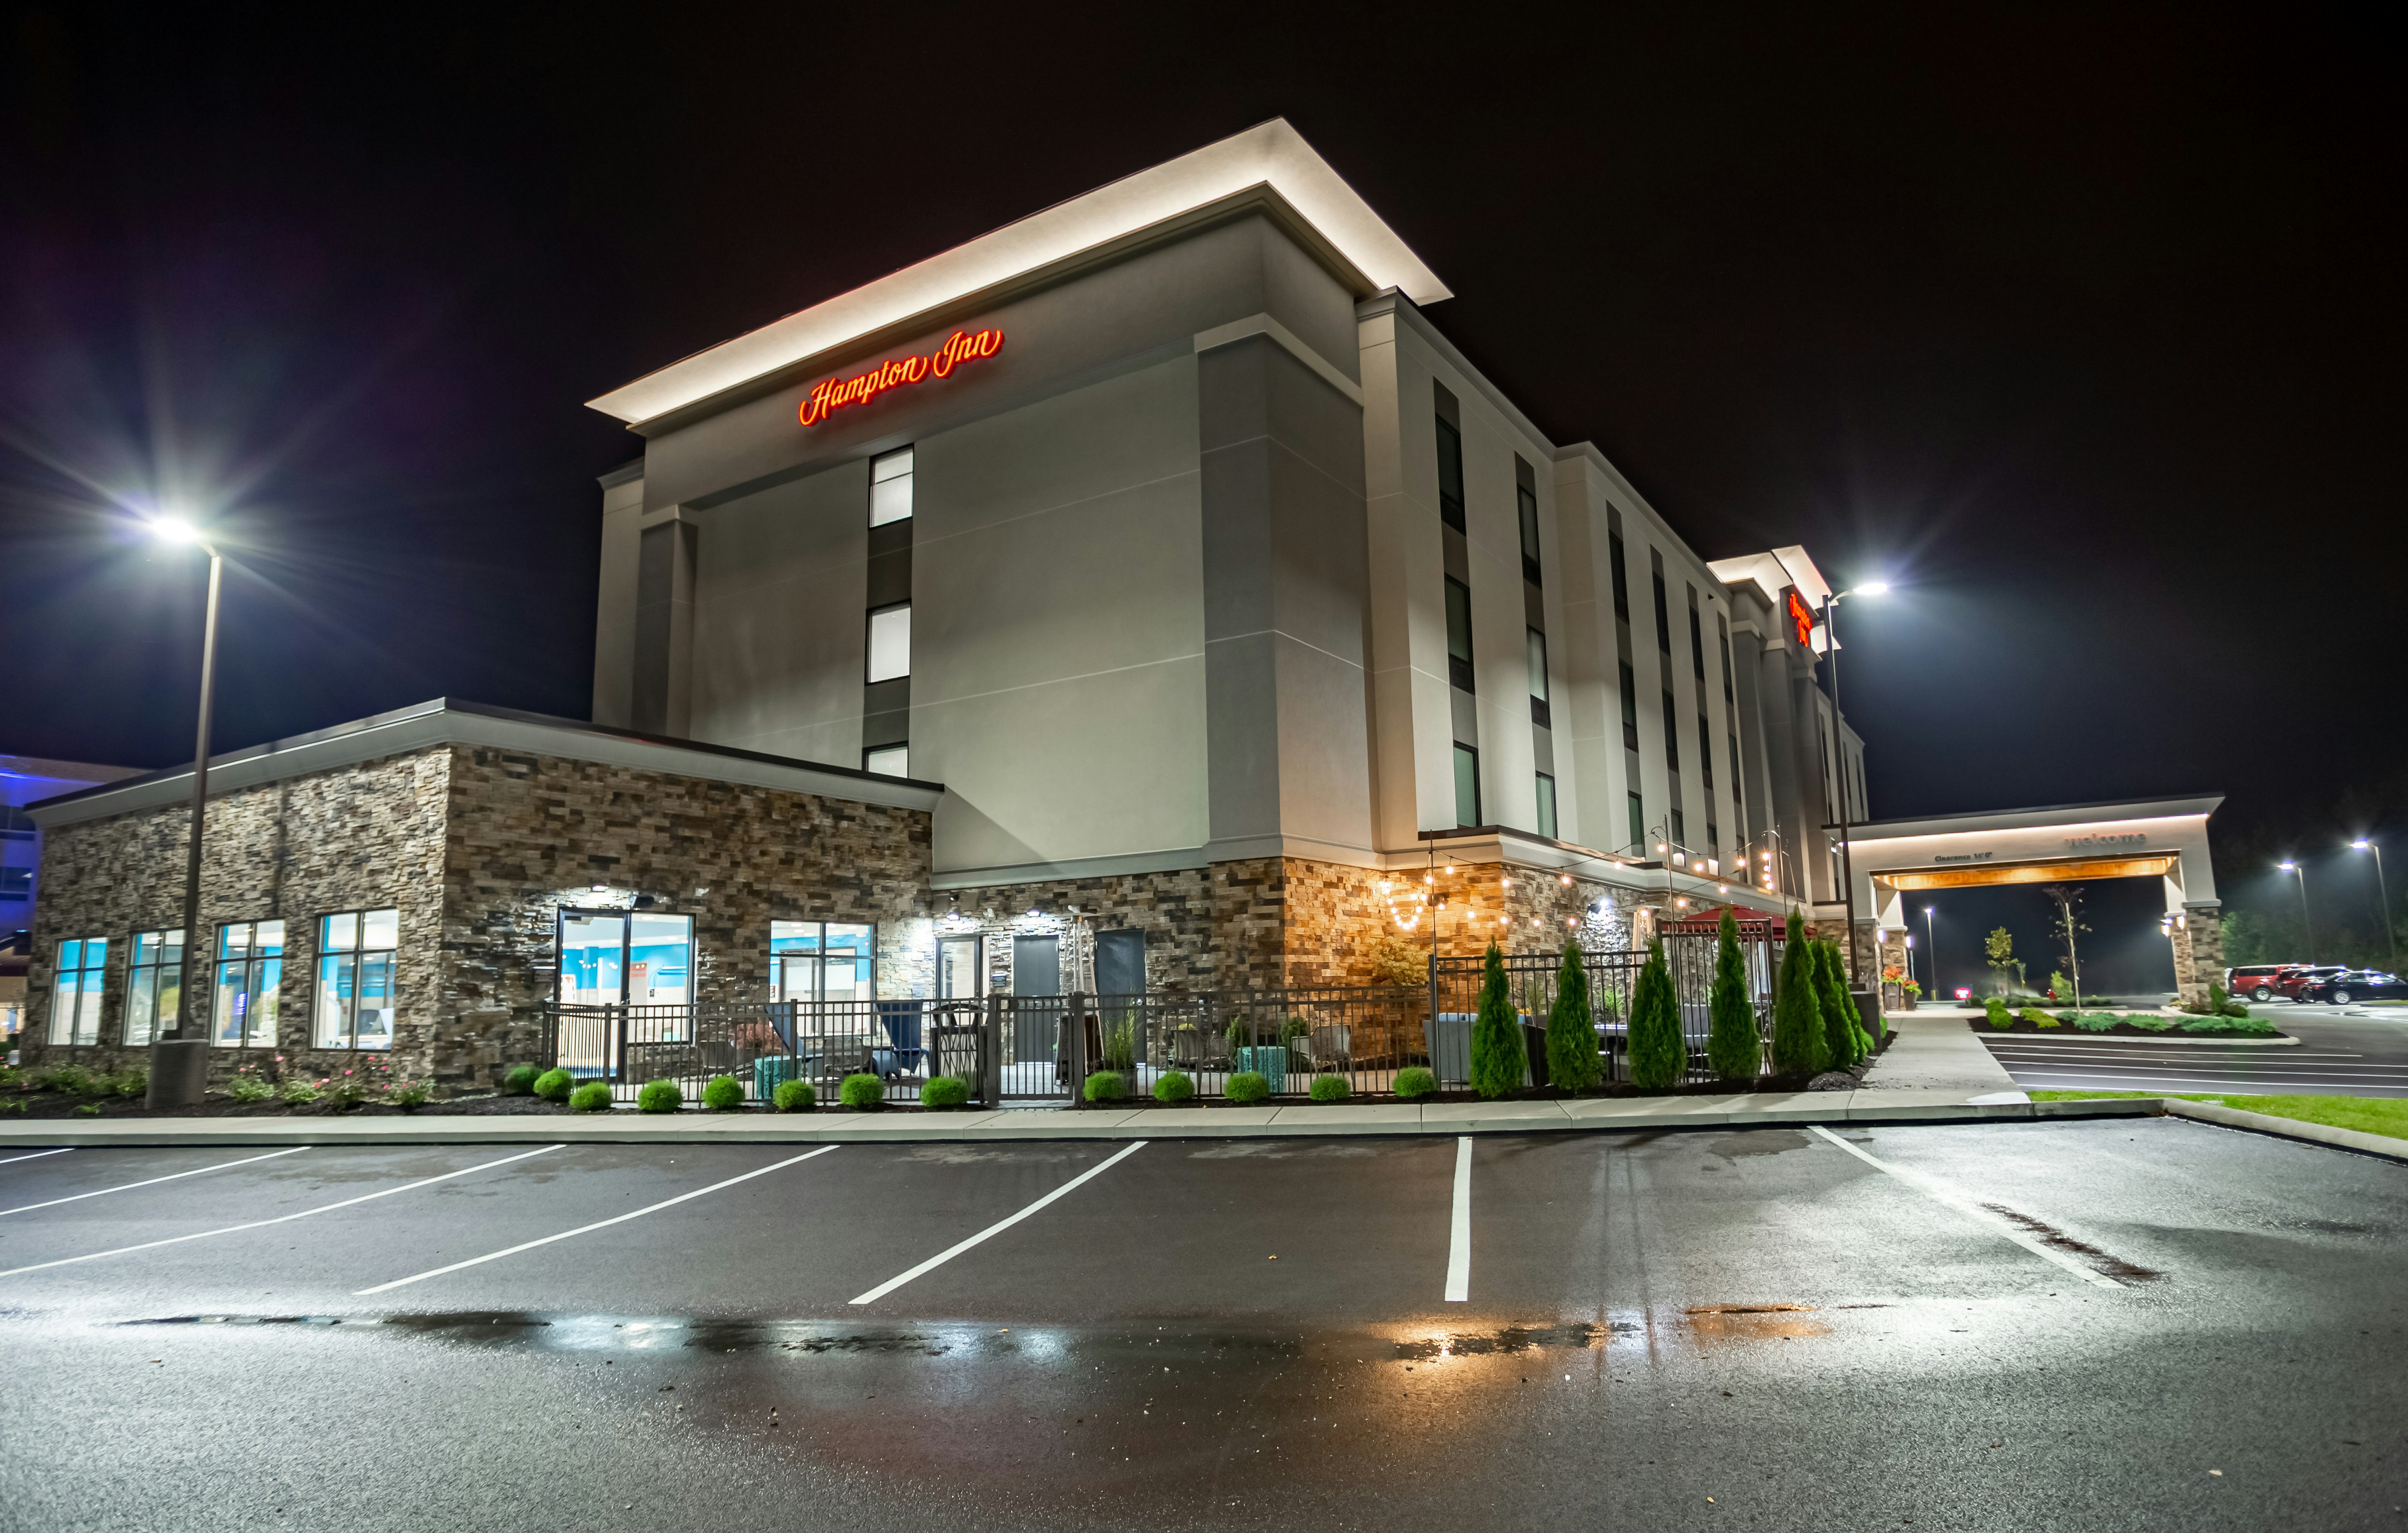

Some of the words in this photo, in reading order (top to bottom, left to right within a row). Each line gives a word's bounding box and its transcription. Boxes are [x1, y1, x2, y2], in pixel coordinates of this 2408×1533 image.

[799, 356, 931, 426] Hampton
[932, 329, 1004, 378] Inn
[2064, 833, 2147, 847] welcome
